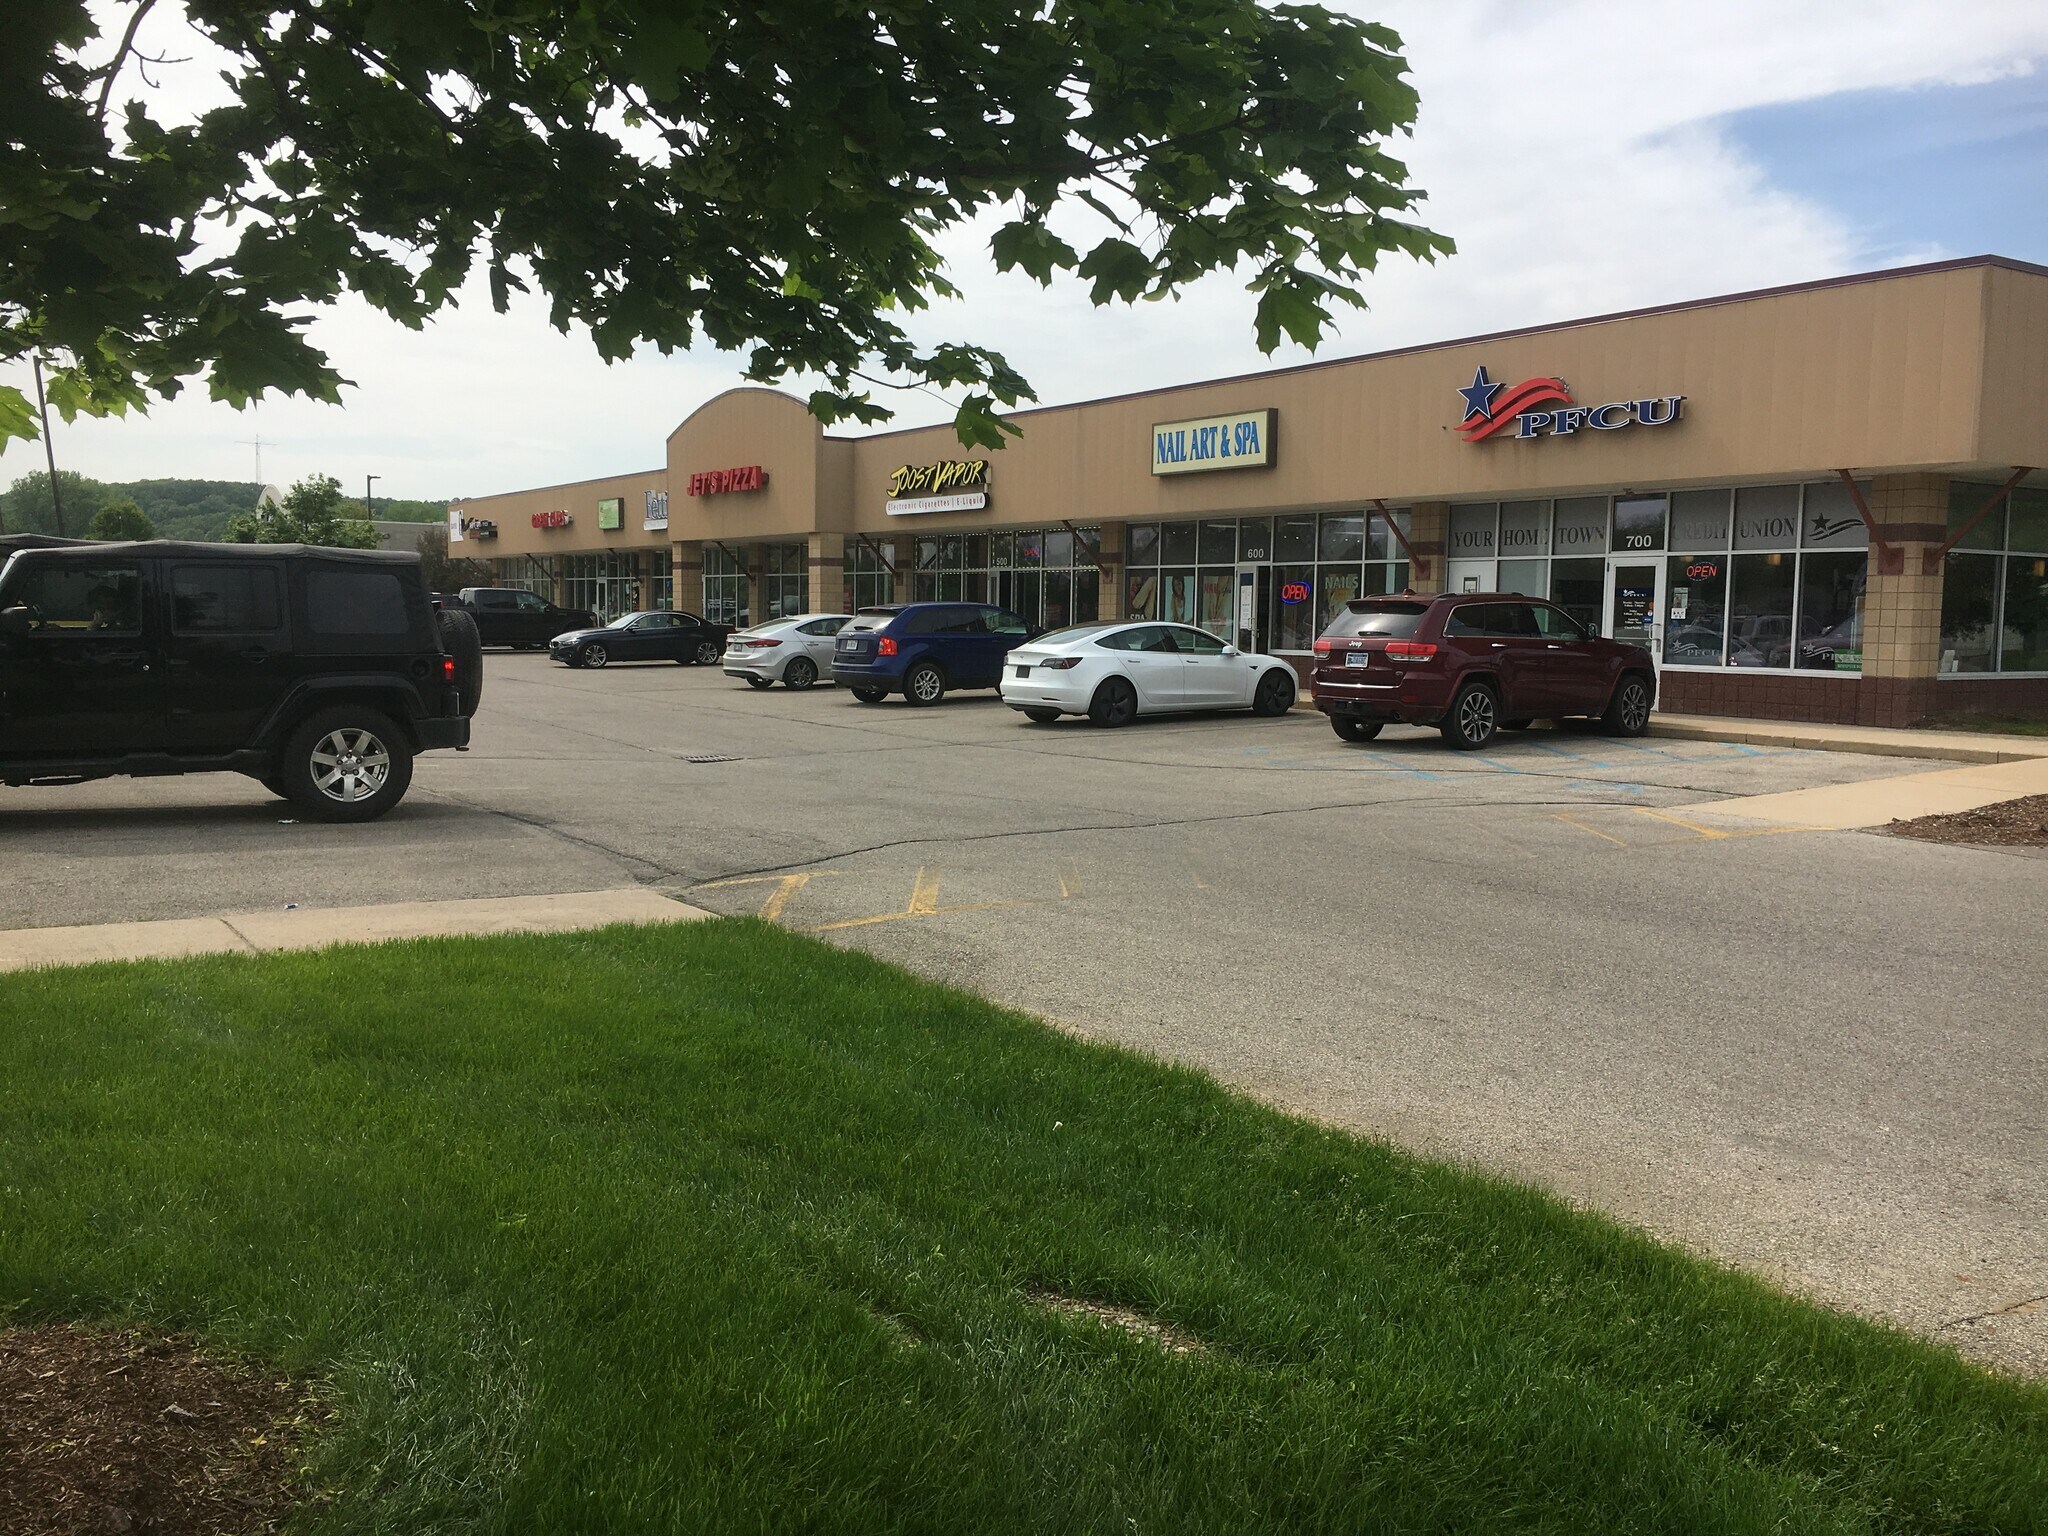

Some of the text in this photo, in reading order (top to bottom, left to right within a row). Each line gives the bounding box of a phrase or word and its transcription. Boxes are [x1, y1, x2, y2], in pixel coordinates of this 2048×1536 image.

[1514, 395, 1683, 439] PFCU
[1156, 421, 1260, 464] NAIL ART & SPA
[687, 466, 760, 497] JET'S PIZZA
[886, 460, 985, 498] JOOST VAPOR
[918, 500, 950, 510] Cigarettes
[1454, 530, 1493, 548] YOUR
[1557, 526, 1606, 544] TOWN
[1740, 517, 1796, 538] UNION
[1626, 535, 1652, 548] 700
[1247, 548, 1264, 559] 600
[996, 557, 1008, 566] 500
[1686, 565, 1717, 578] OPEN
[1325, 576, 1359, 590] NAILS
[1281, 584, 1308, 600] OPEN
[1348, 641, 1363, 649] Jeep
